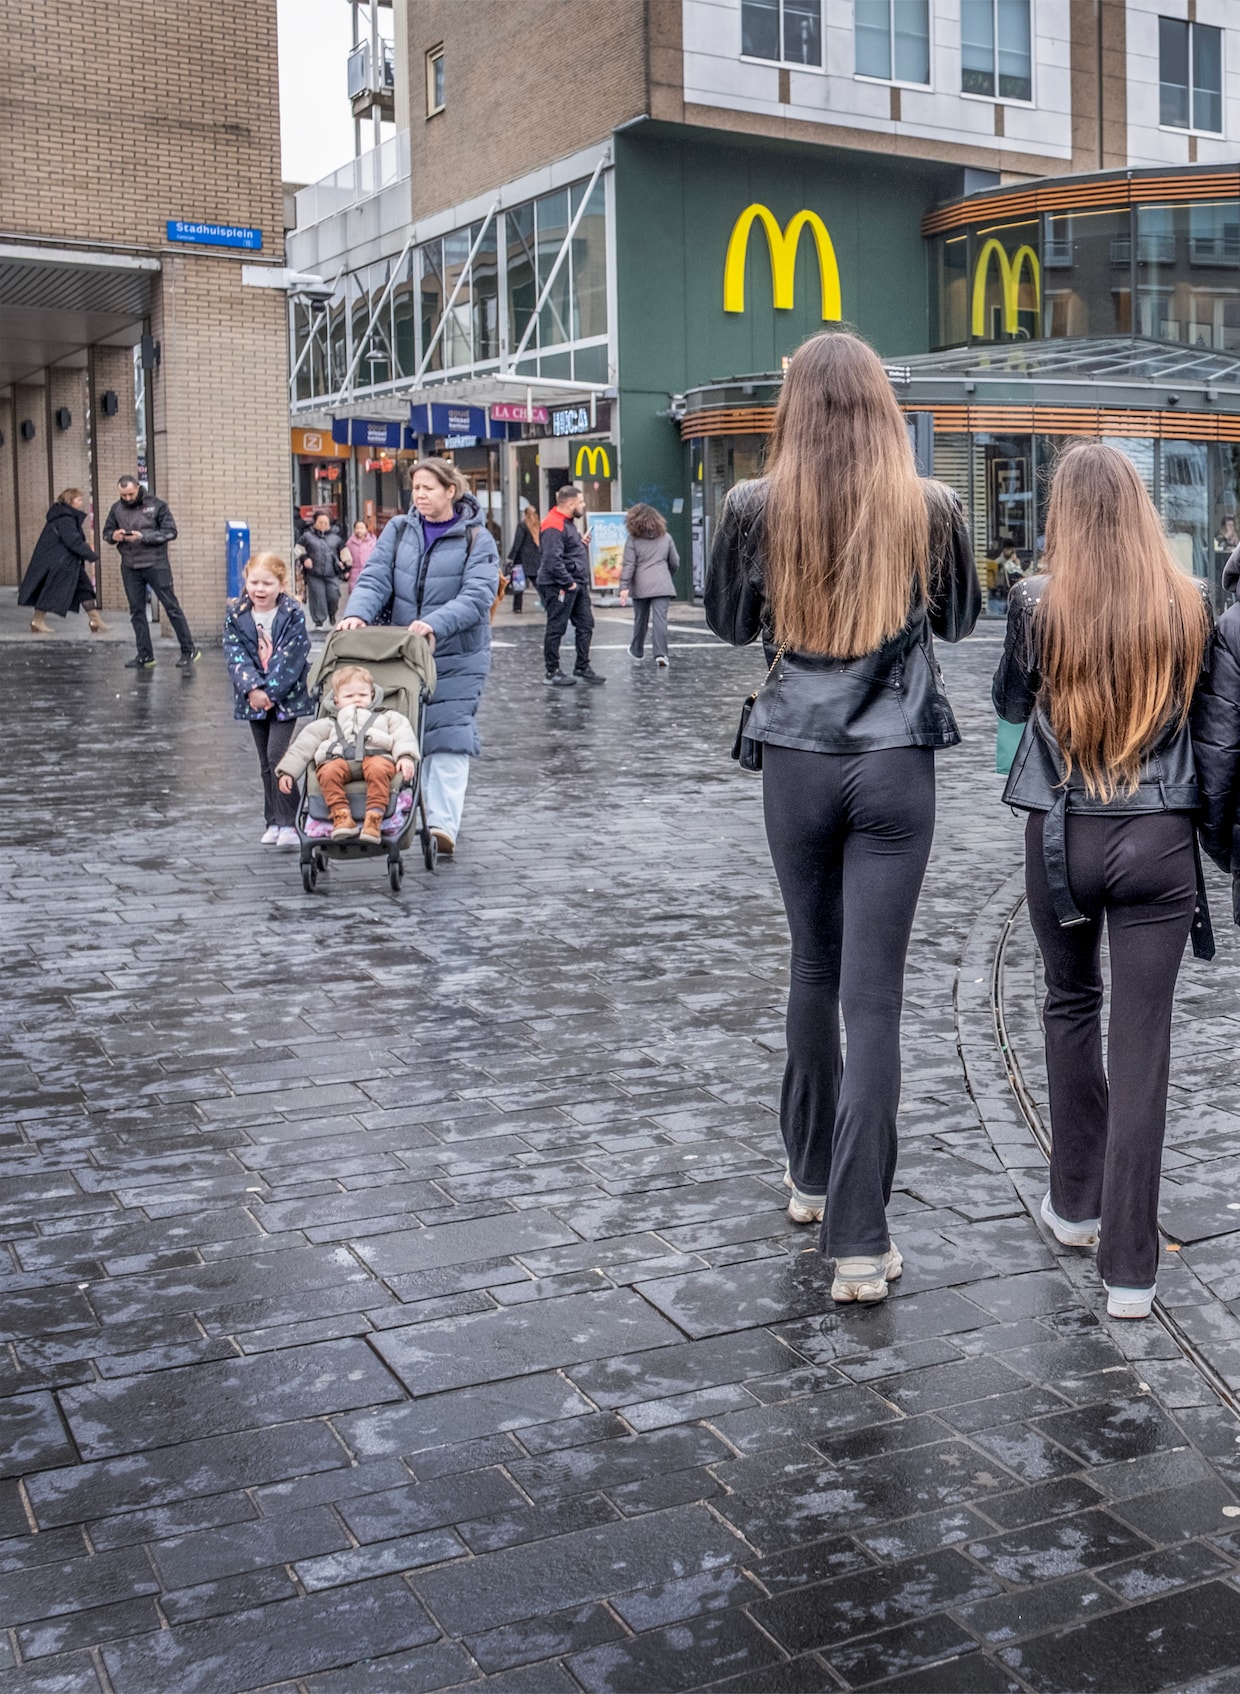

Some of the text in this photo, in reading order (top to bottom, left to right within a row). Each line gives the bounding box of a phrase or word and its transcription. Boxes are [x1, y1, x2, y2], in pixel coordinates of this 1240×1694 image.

[176, 222, 254, 239] Stadhuisplein
[495, 406, 545, 421] LA CHCA
